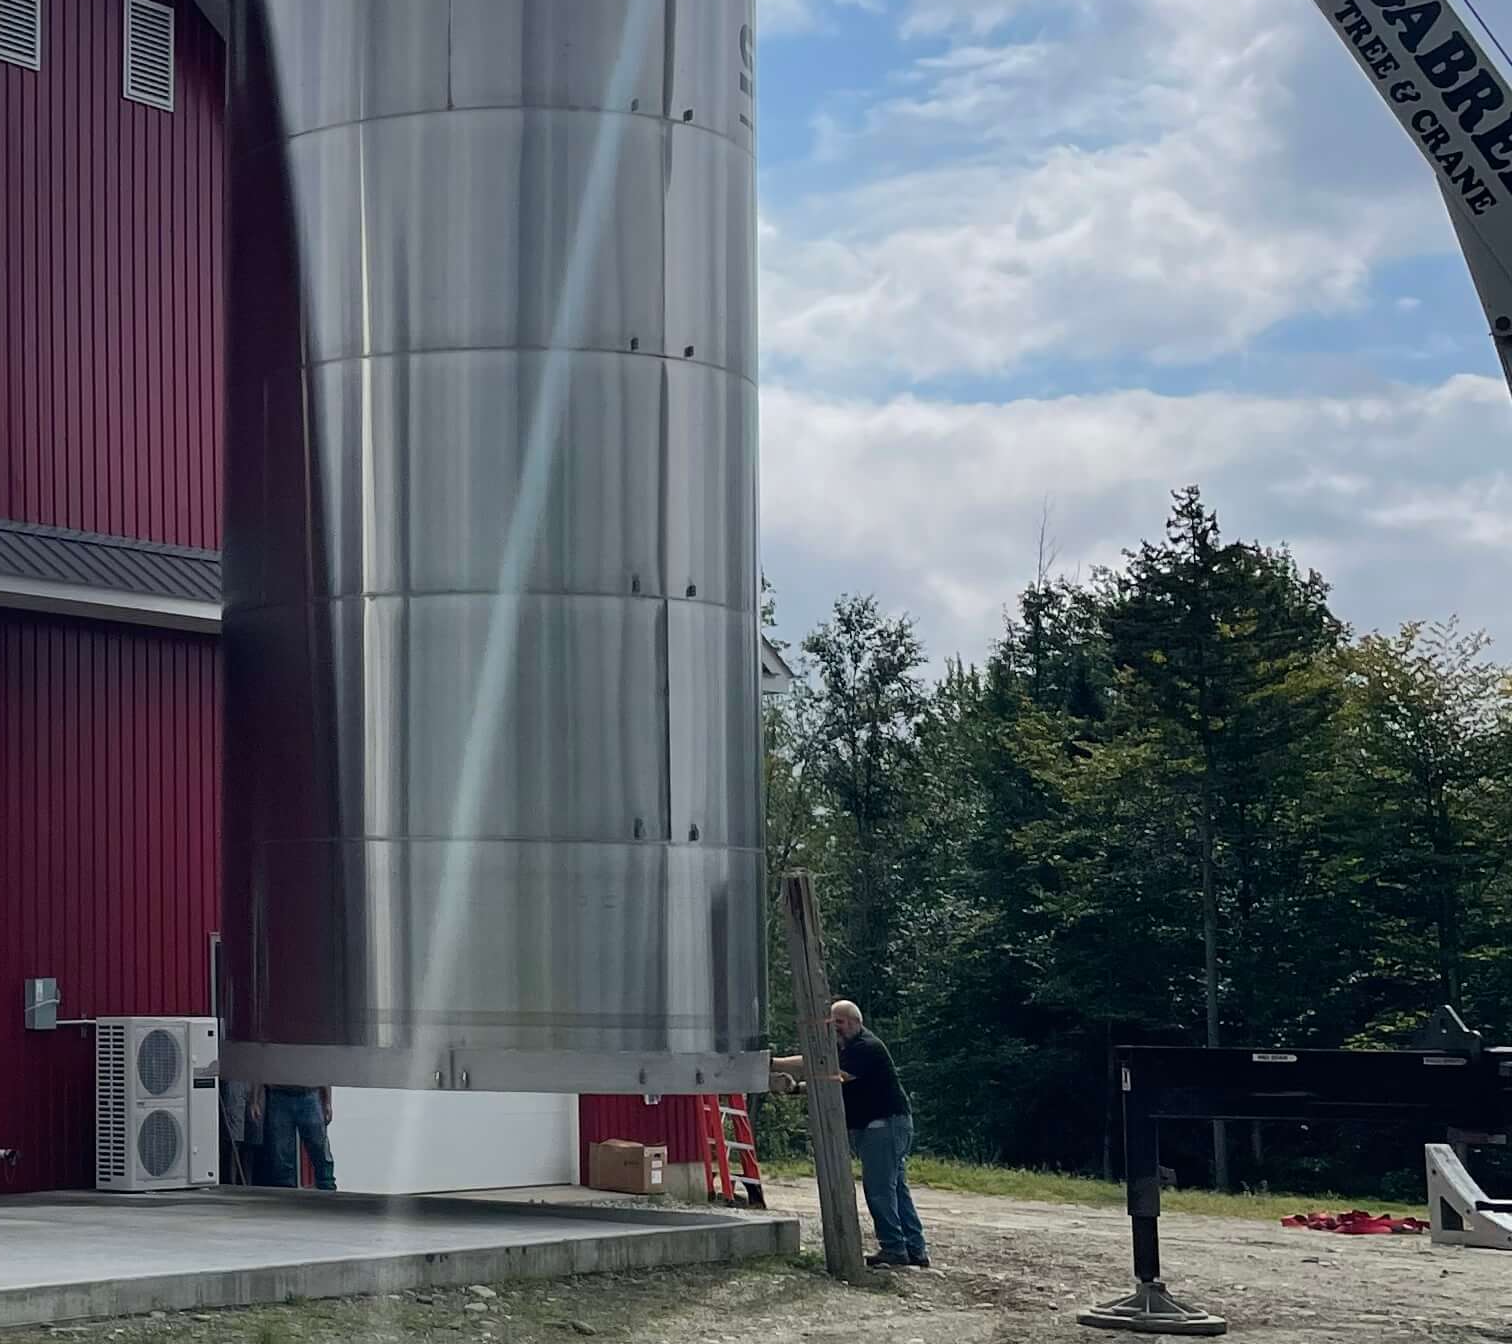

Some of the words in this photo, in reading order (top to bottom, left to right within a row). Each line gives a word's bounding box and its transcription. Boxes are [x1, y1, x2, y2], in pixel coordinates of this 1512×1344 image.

[1334, 0, 1401, 81] TREE
[1390, 80, 1421, 103] &
[1411, 109, 1497, 215] CRANE
